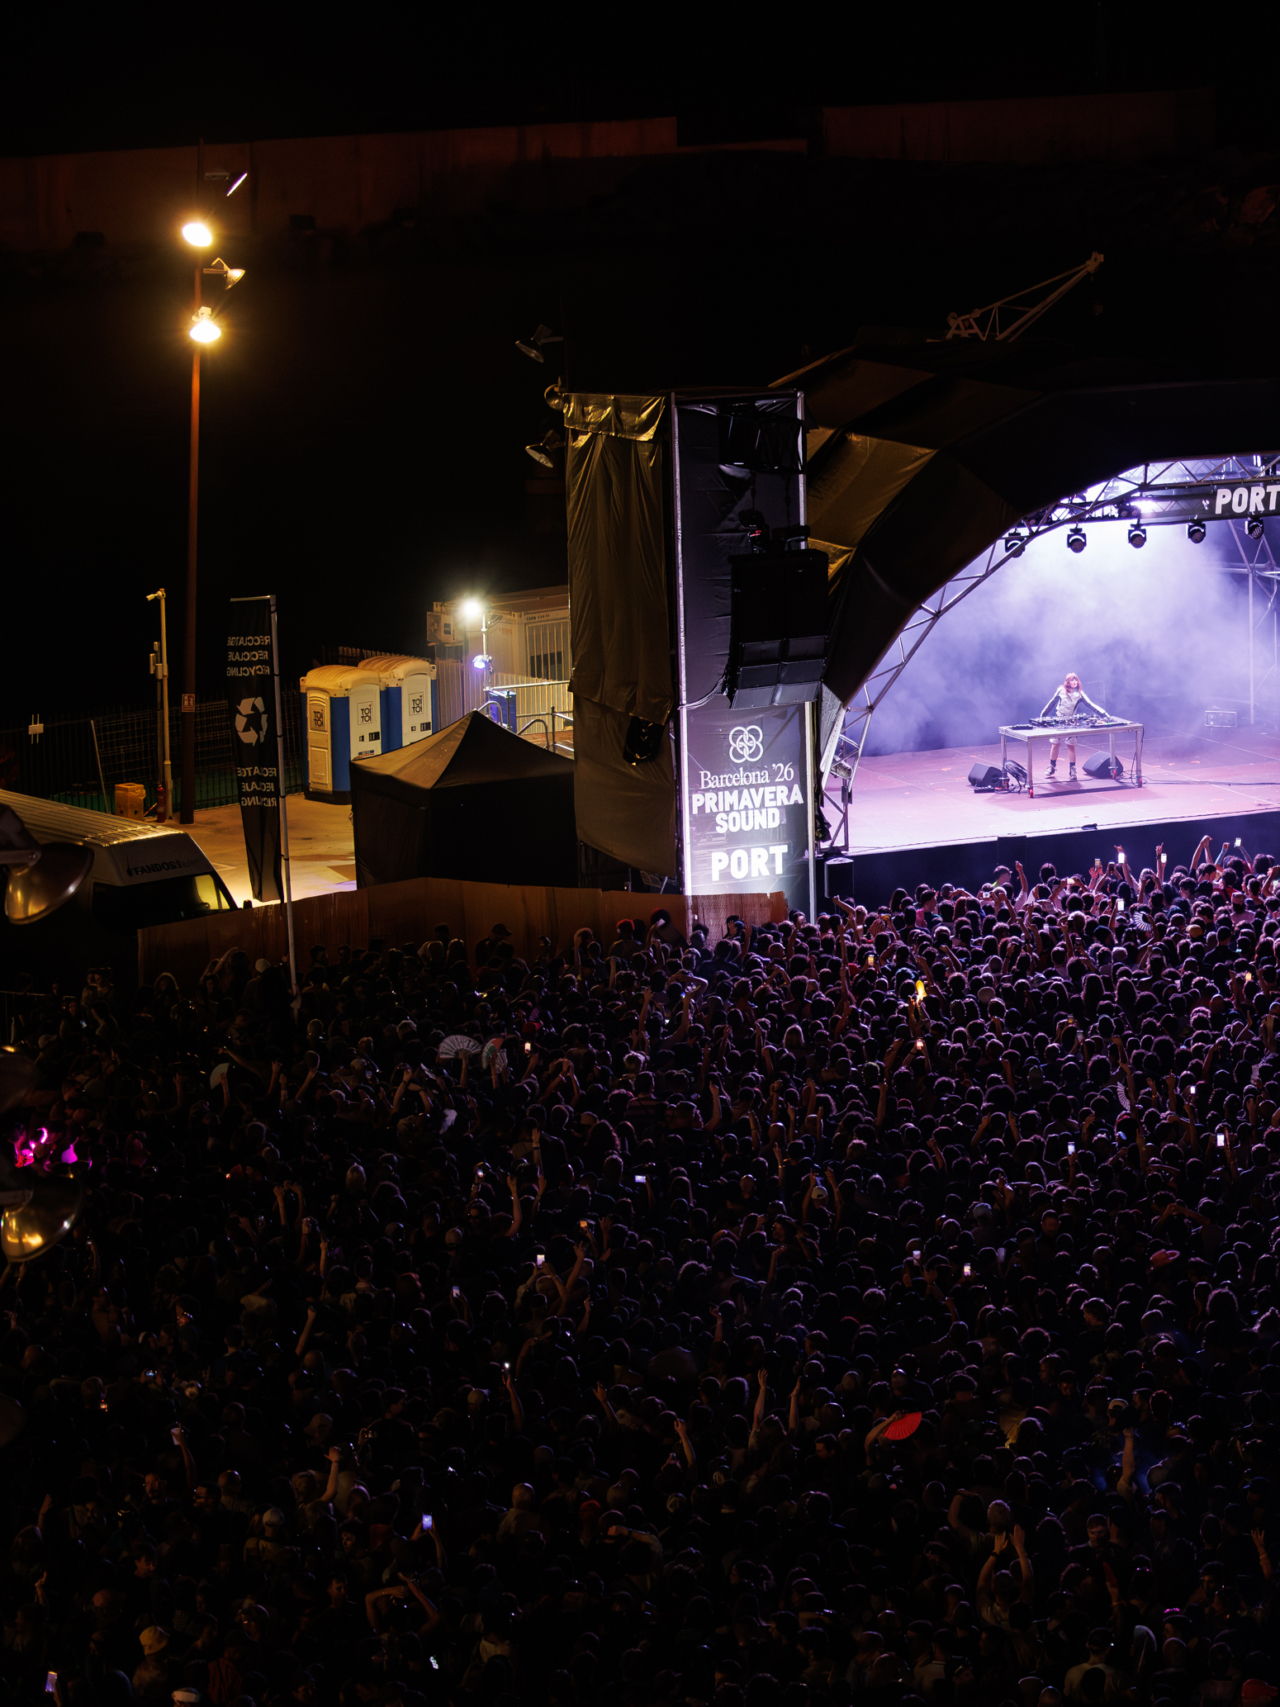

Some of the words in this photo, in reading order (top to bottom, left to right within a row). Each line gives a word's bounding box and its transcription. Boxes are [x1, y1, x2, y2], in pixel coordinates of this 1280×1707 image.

[699, 765, 770, 790] Barcelona
[691, 783, 804, 814] PRIMAVERA
[715, 807, 780, 834] SOUND
[711, 844, 788, 882] PORT
